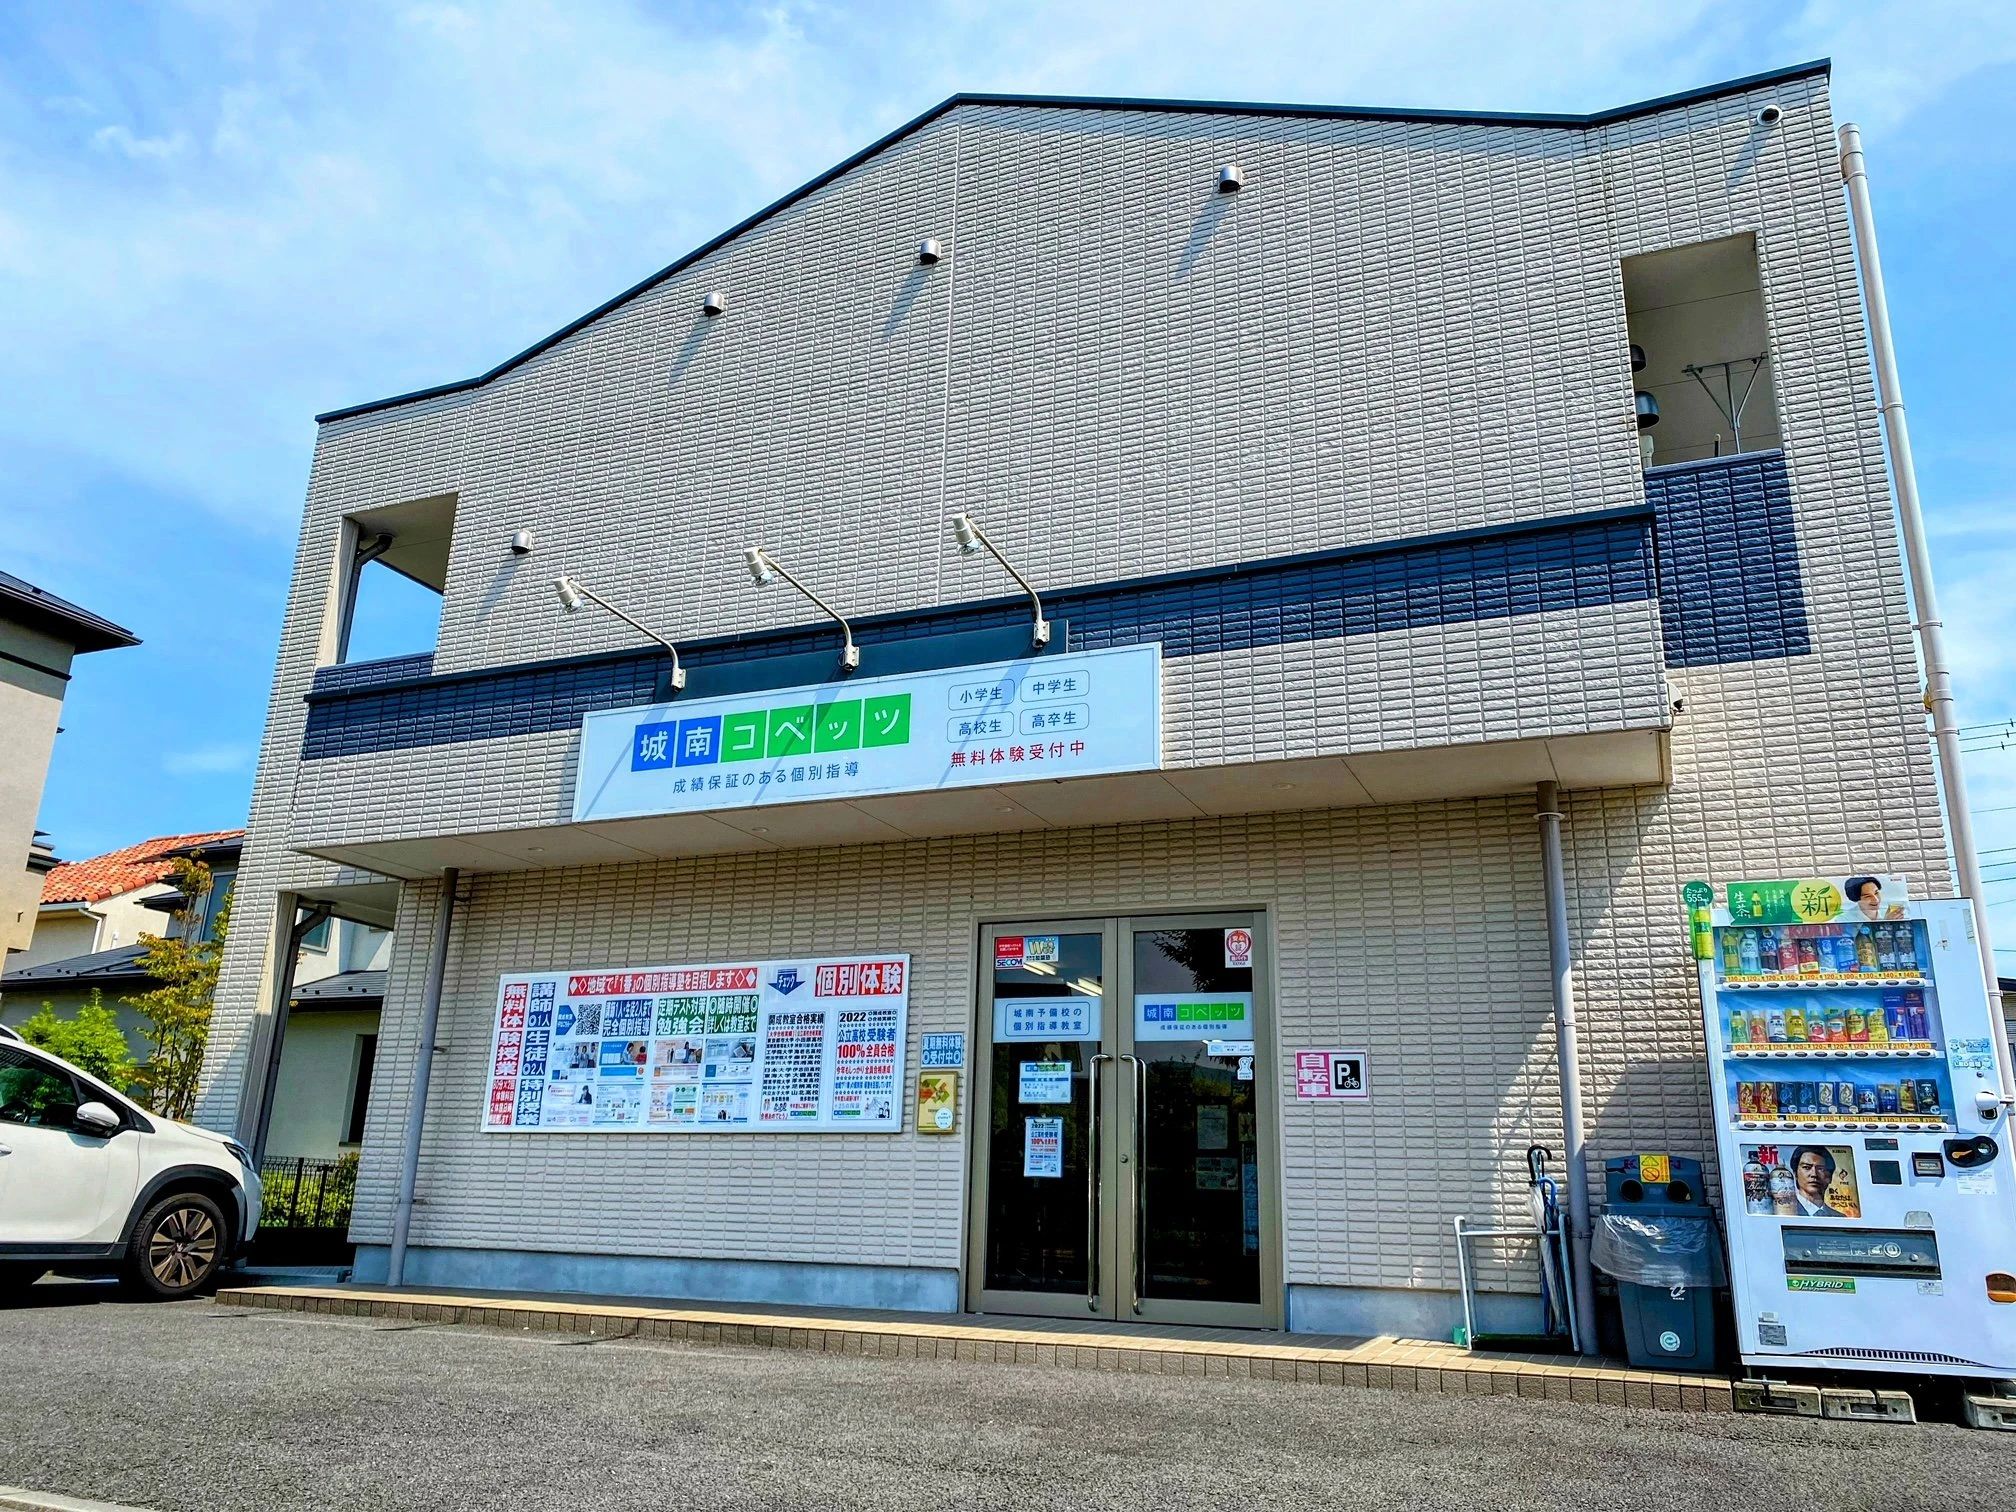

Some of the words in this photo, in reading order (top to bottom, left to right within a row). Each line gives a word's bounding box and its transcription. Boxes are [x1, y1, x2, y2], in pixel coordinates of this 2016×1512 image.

[959, 686, 1003, 704] 小学生
[1032, 677, 1077, 696] 中学生
[958, 718, 1002, 737] 高校生
[1031, 710, 1077, 729] 高卒生
[636, 706, 903, 764] 城南コベッツ
[950, 739, 1086, 768] 無料体験受付中
[672, 760, 860, 794] 成績保証のある個別指導
[1800, 885, 1831, 917] 新
[997, 958, 1022, 967] SECOM
[778, 974, 796, 988] チェック
[817, 963, 902, 996] 個別体験
[659, 998, 706, 1016] 定期テスト対策
[1013, 1008, 1082, 1018] 城南予備校の
[1145, 1006, 1242, 1019] 城南コベッツ
[657, 1016, 704, 1035] 勉強会
[707, 1015, 756, 1033] 詳しくは教室まで
[840, 1012, 866, 1022] 2022
[1013, 1021, 1082, 1031] 個別指導教室
[603, 1018, 650, 1036] 完全個別指導
[525, 1031, 548, 1061] 生徒
[1298, 1054, 1329, 1096] 自転車
[1337, 1063, 1351, 1085] P
[516, 1079, 544, 1125] 特別授業
[1758, 1145, 1778, 1165] 新
[1800, 1280, 1844, 1290] HYBRID
